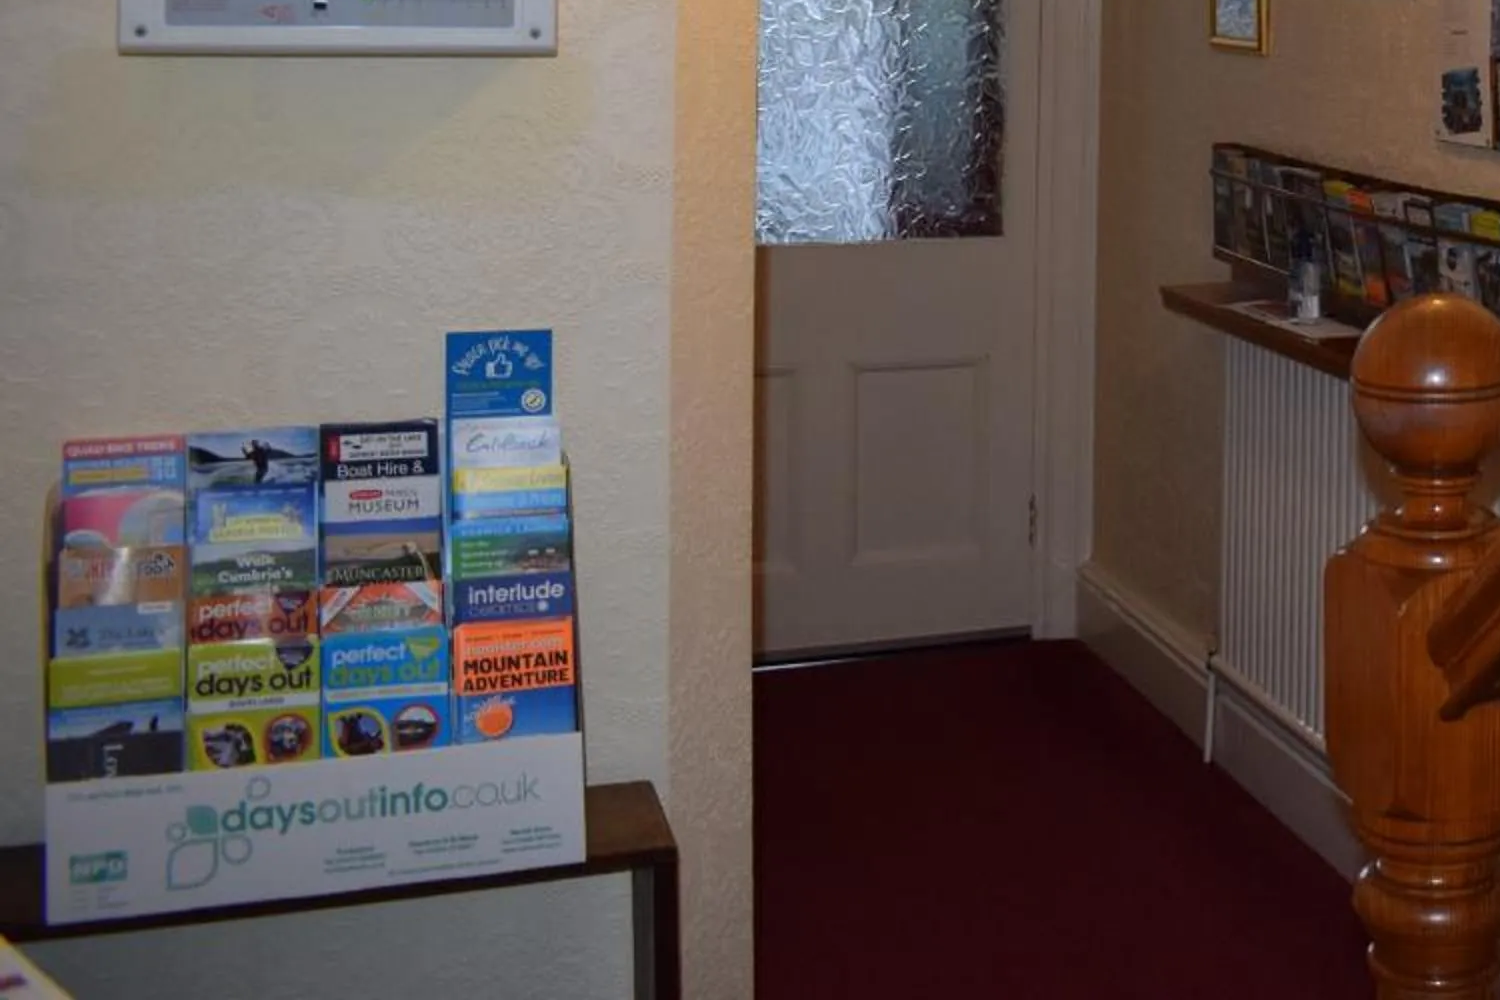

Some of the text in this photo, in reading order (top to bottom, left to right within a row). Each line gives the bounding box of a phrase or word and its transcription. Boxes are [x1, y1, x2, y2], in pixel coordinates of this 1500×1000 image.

[337, 459, 425, 479] Boat Hire &
[348, 499, 420, 514] MUSEUM
[217, 566, 294, 583] Cumbria's
[468, 580, 566, 605] interlude
[269, 612, 310, 634] out
[197, 656, 274, 680] perfect
[332, 642, 406, 669] perfect
[463, 650, 569, 676] MOUNTAIN
[195, 672, 263, 697] days
[269, 665, 313, 690] out
[328, 656, 441, 688] days out
[463, 668, 570, 693] ADVENTURE
[221, 771, 542, 835] daysoutinfo.co.uk
